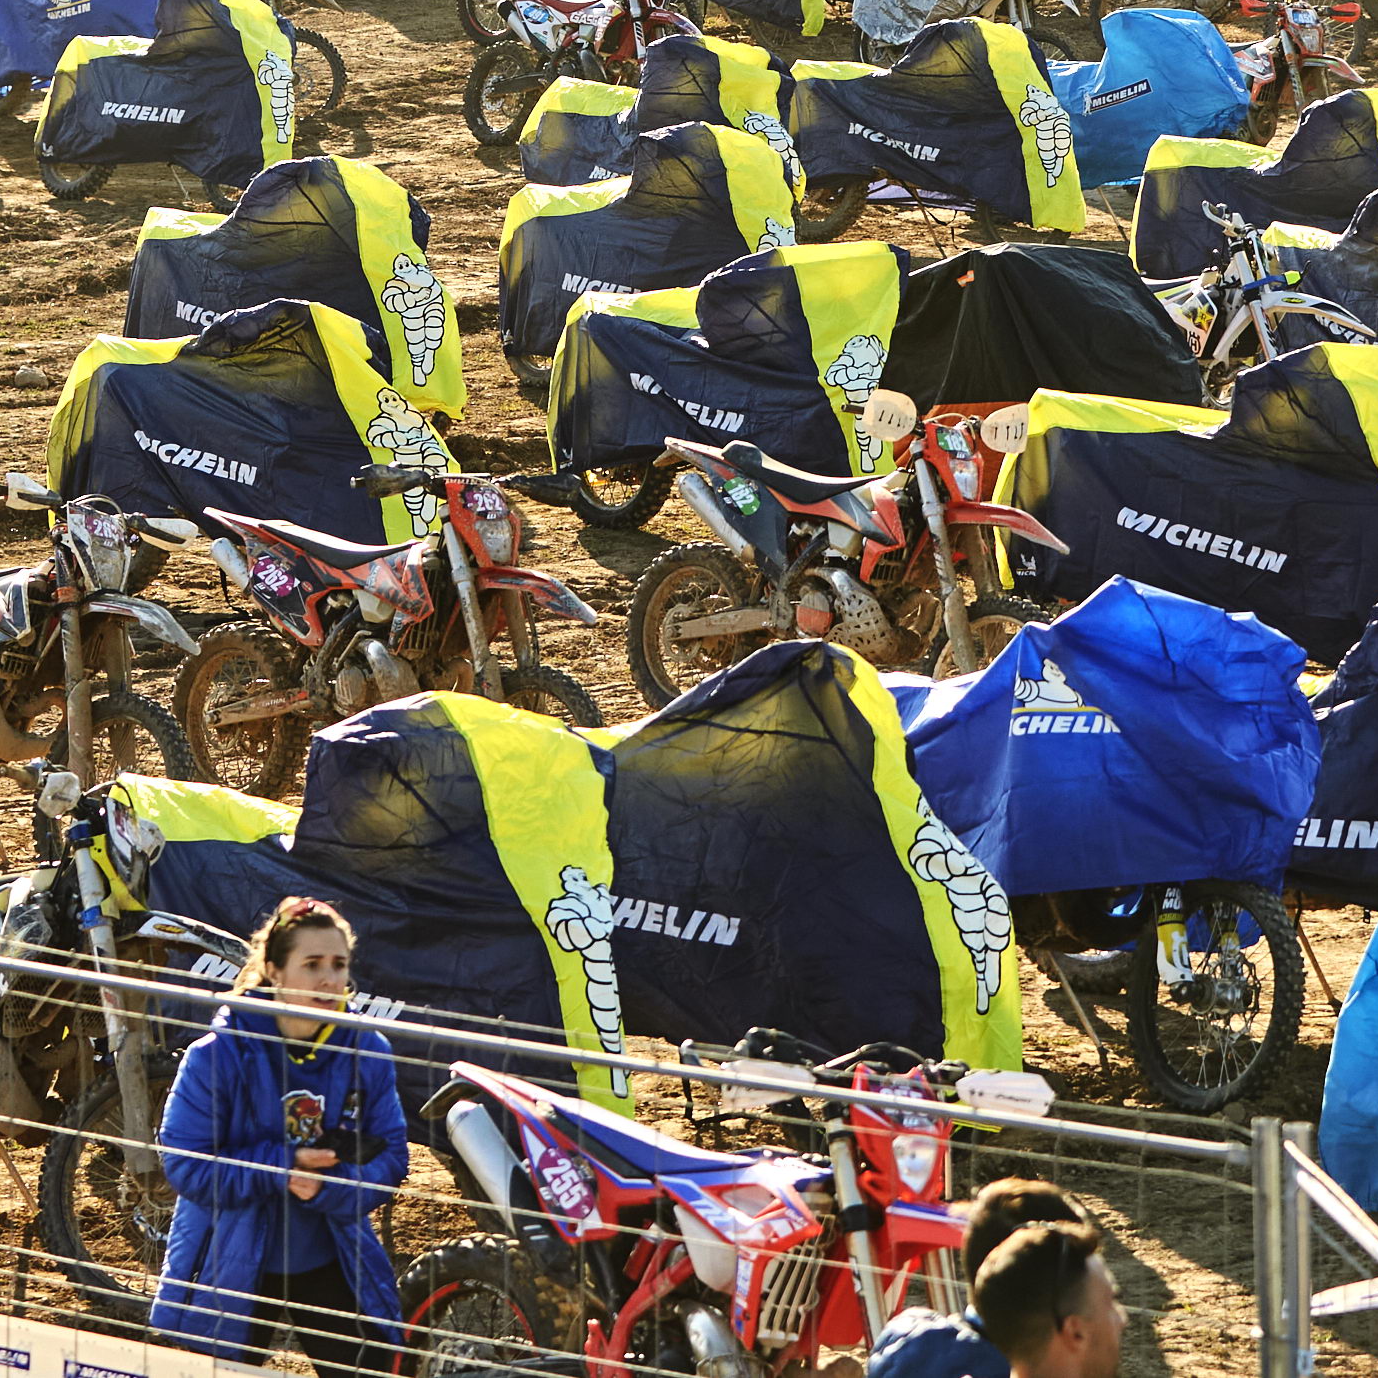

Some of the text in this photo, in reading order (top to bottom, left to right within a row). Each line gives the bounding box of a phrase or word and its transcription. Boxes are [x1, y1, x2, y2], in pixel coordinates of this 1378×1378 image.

[1093, 81, 1148, 108] MICHELIN
[473, 491, 503, 512] 262
[727, 483, 755, 509] 182
[1116, 506, 1288, 574] MICHELIN
[256, 564, 289, 591] 262
[542, 1156, 585, 1212] 255
